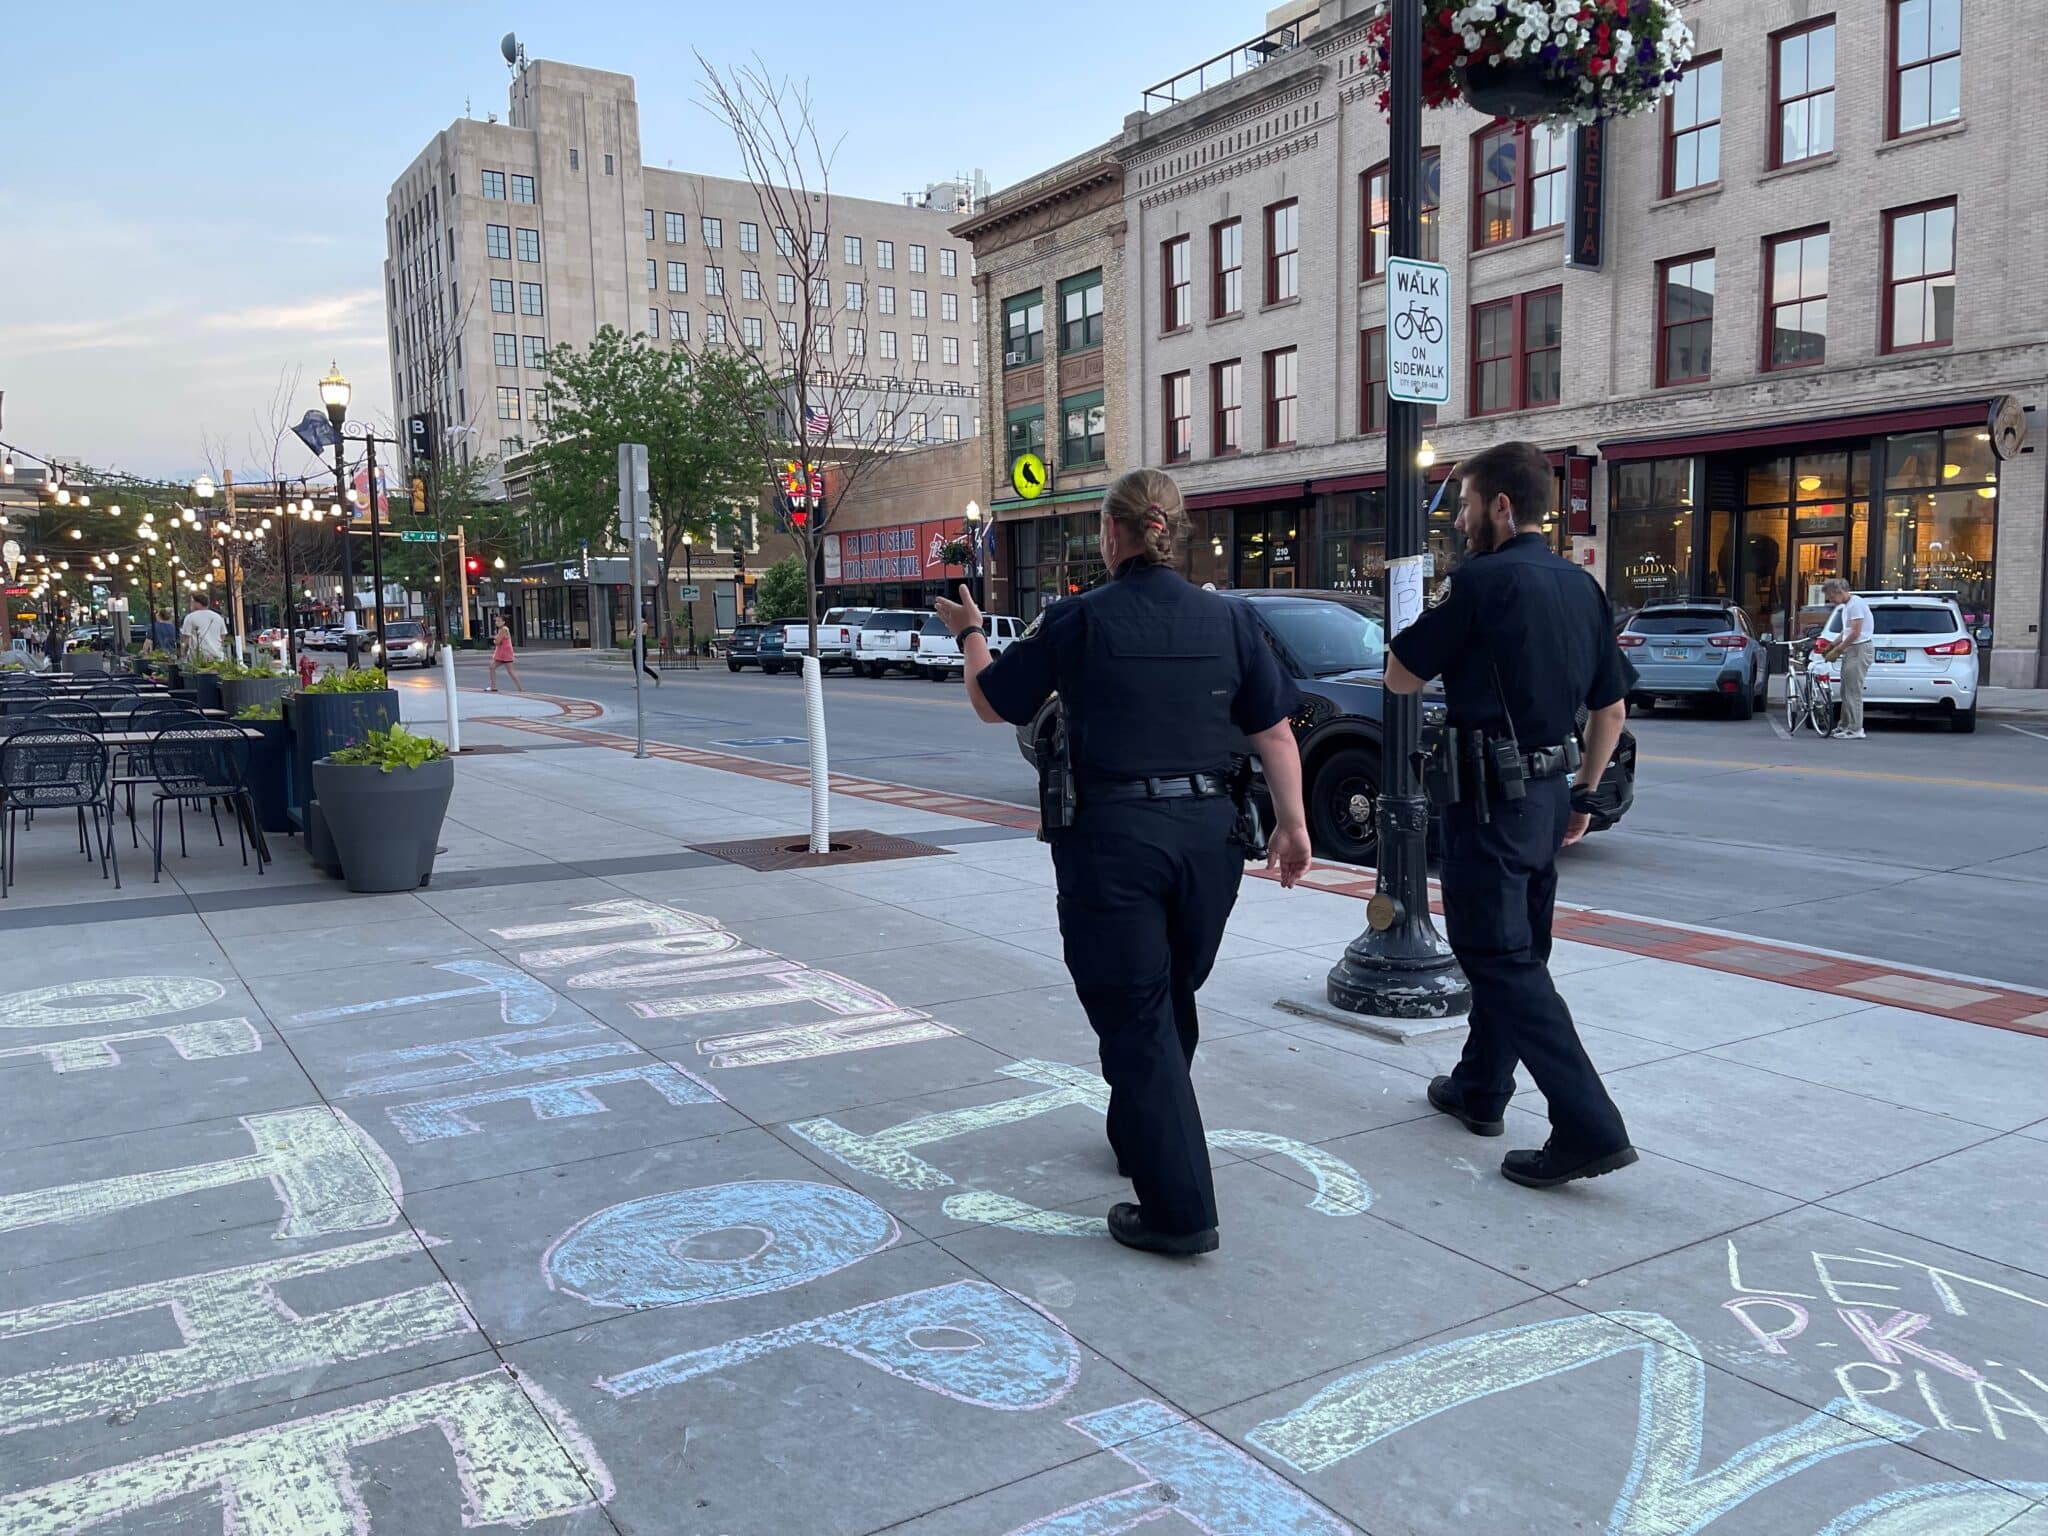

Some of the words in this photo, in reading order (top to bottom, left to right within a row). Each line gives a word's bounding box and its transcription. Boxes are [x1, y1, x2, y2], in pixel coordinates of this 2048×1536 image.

[1397, 271, 1440, 297] WALK
[1411, 346, 1426, 361] ON
[1393, 361, 1445, 379] SIDEWALK
[847, 533, 874, 556] PROUD
[875, 531, 886, 553] TO
[887, 528, 916, 552] SERVE
[1275, 547, 1289, 556] 210
[844, 559, 870, 581] THOSE
[870, 557, 890, 579] WHO
[1624, 563, 1678, 577] TEDDY'S
[682, 587, 692, 599] P
[1333, 579, 1374, 589] PRAIRIE
[490, 898, 962, 1069] TRUTH
[288, 959, 728, 1144] THE
[1726, 1238, 2048, 1317] LET
[1833, 1361, 2048, 1441] PLA
